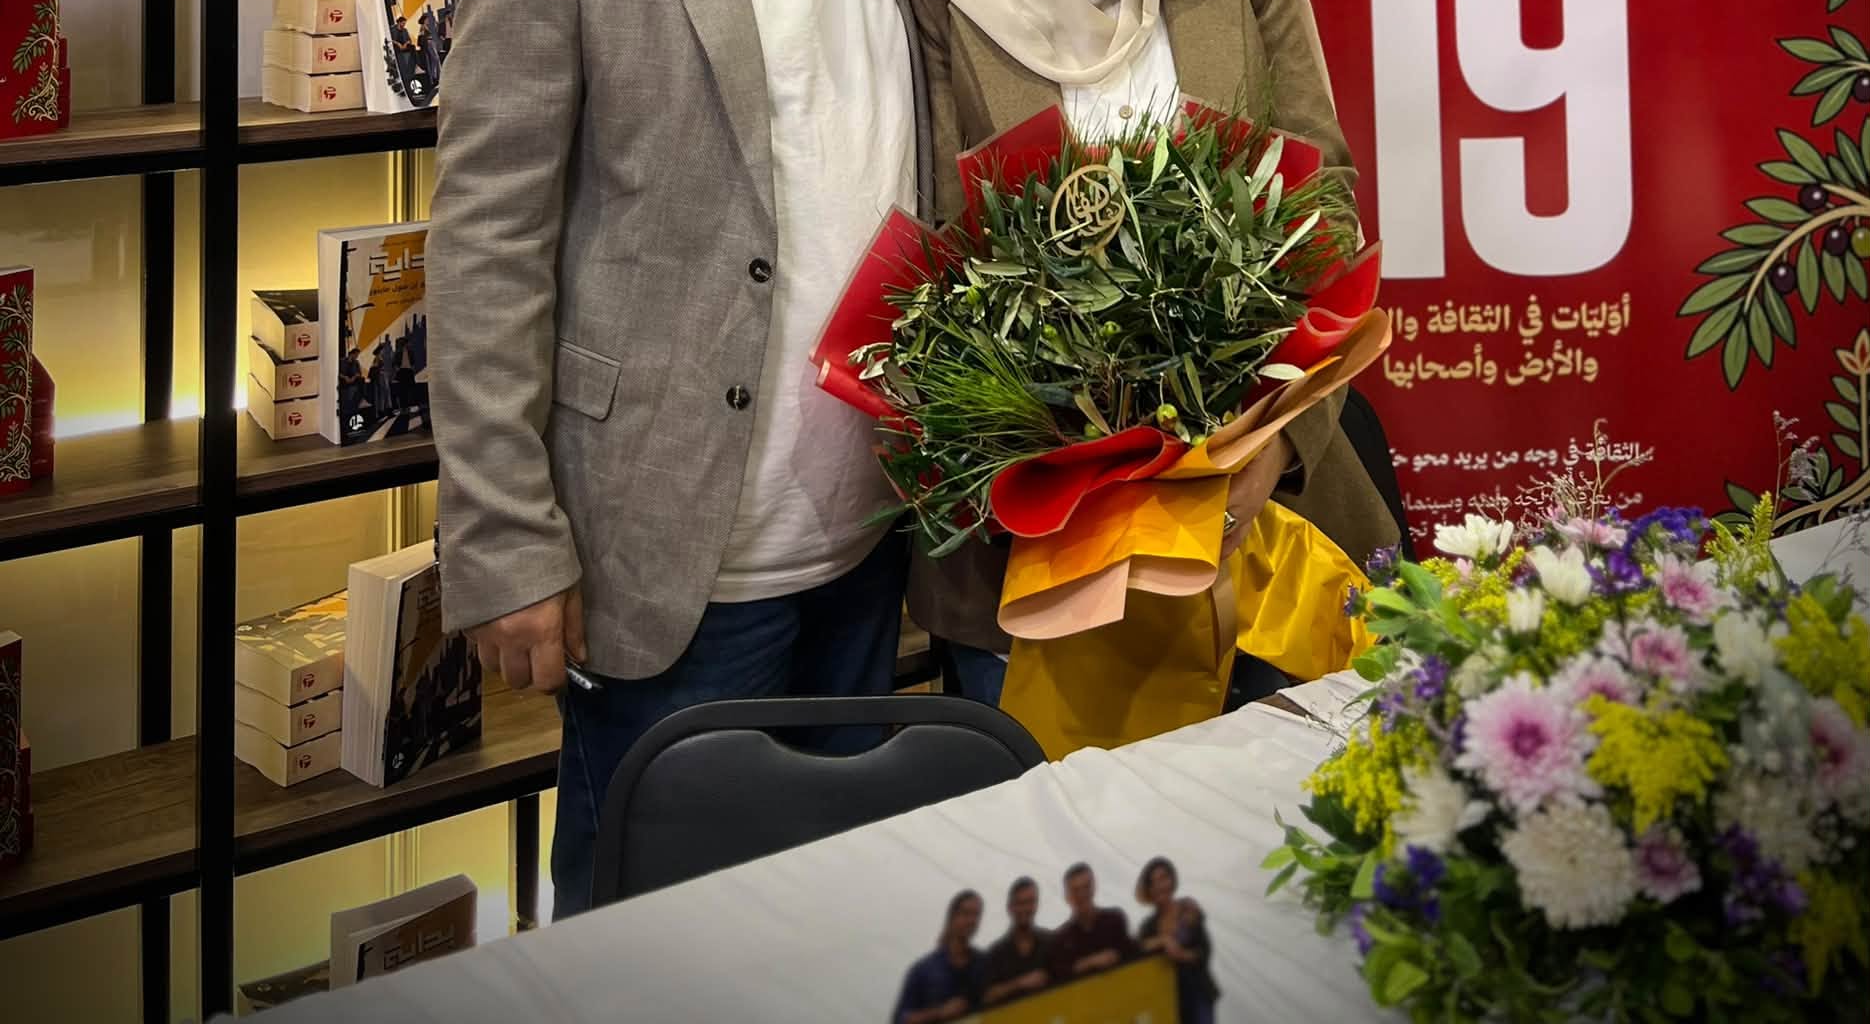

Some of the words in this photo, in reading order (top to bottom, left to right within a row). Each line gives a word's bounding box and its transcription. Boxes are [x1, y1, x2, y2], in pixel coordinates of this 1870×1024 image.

[1388, 307, 1419, 342] وال
[1426, 300, 1510, 334] الثقافة
[1518, 294, 1544, 346] في
[1382, 343, 1498, 390] وأصحابها
[1505, 339, 1599, 386] والأرض
[1412, 452, 1449, 473] محو
[1453, 450, 1489, 471] يريد
[1492, 449, 1520, 468] من
[1523, 448, 1558, 468] وجه
